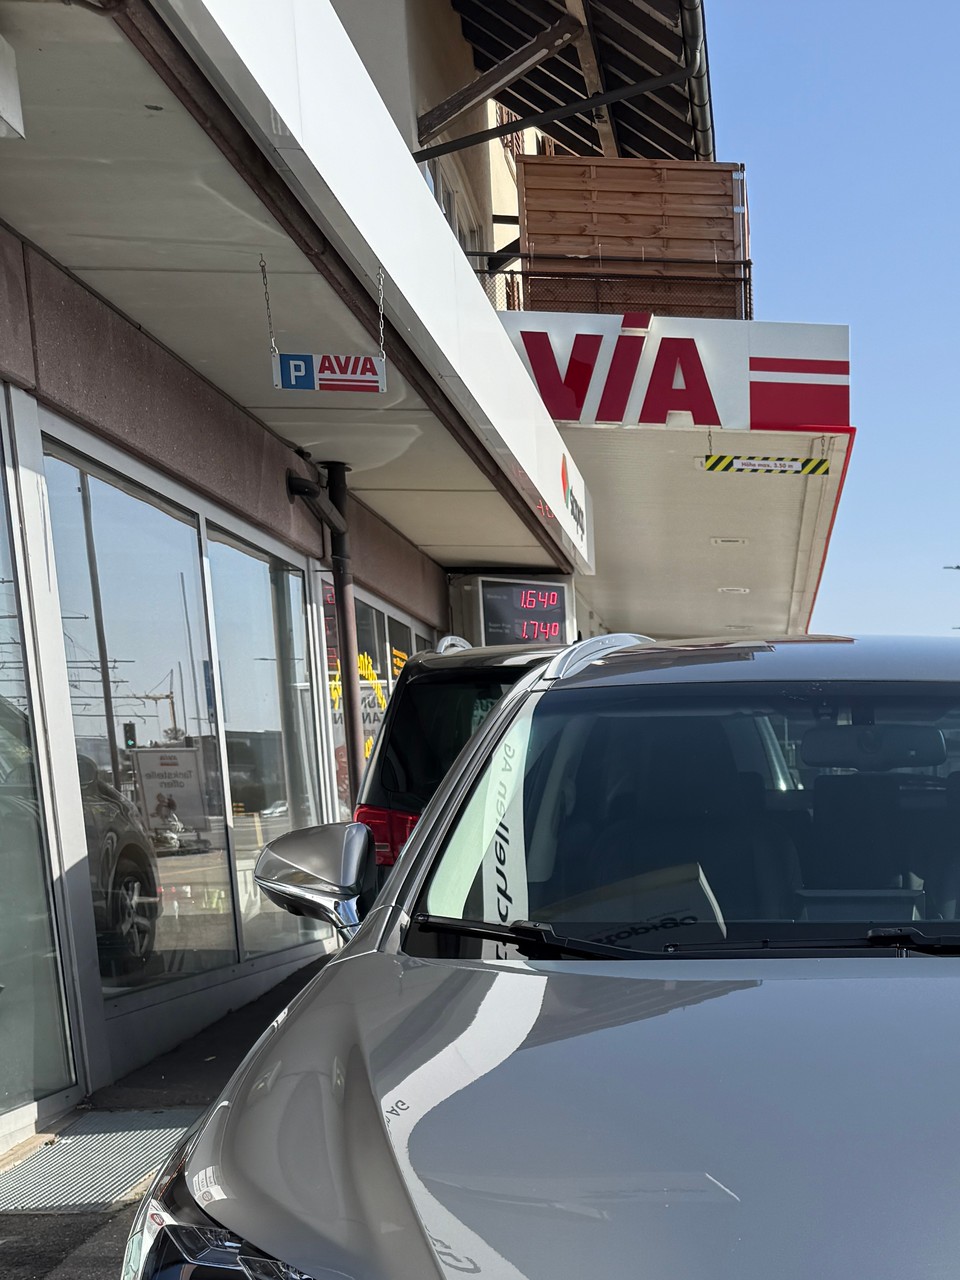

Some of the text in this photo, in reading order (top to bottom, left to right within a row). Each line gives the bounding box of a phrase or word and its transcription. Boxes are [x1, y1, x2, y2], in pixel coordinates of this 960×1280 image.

[289, 354, 379, 385] P AVIA
[520, 312, 722, 426] VIA
[521, 621, 559, 640] 1.740
